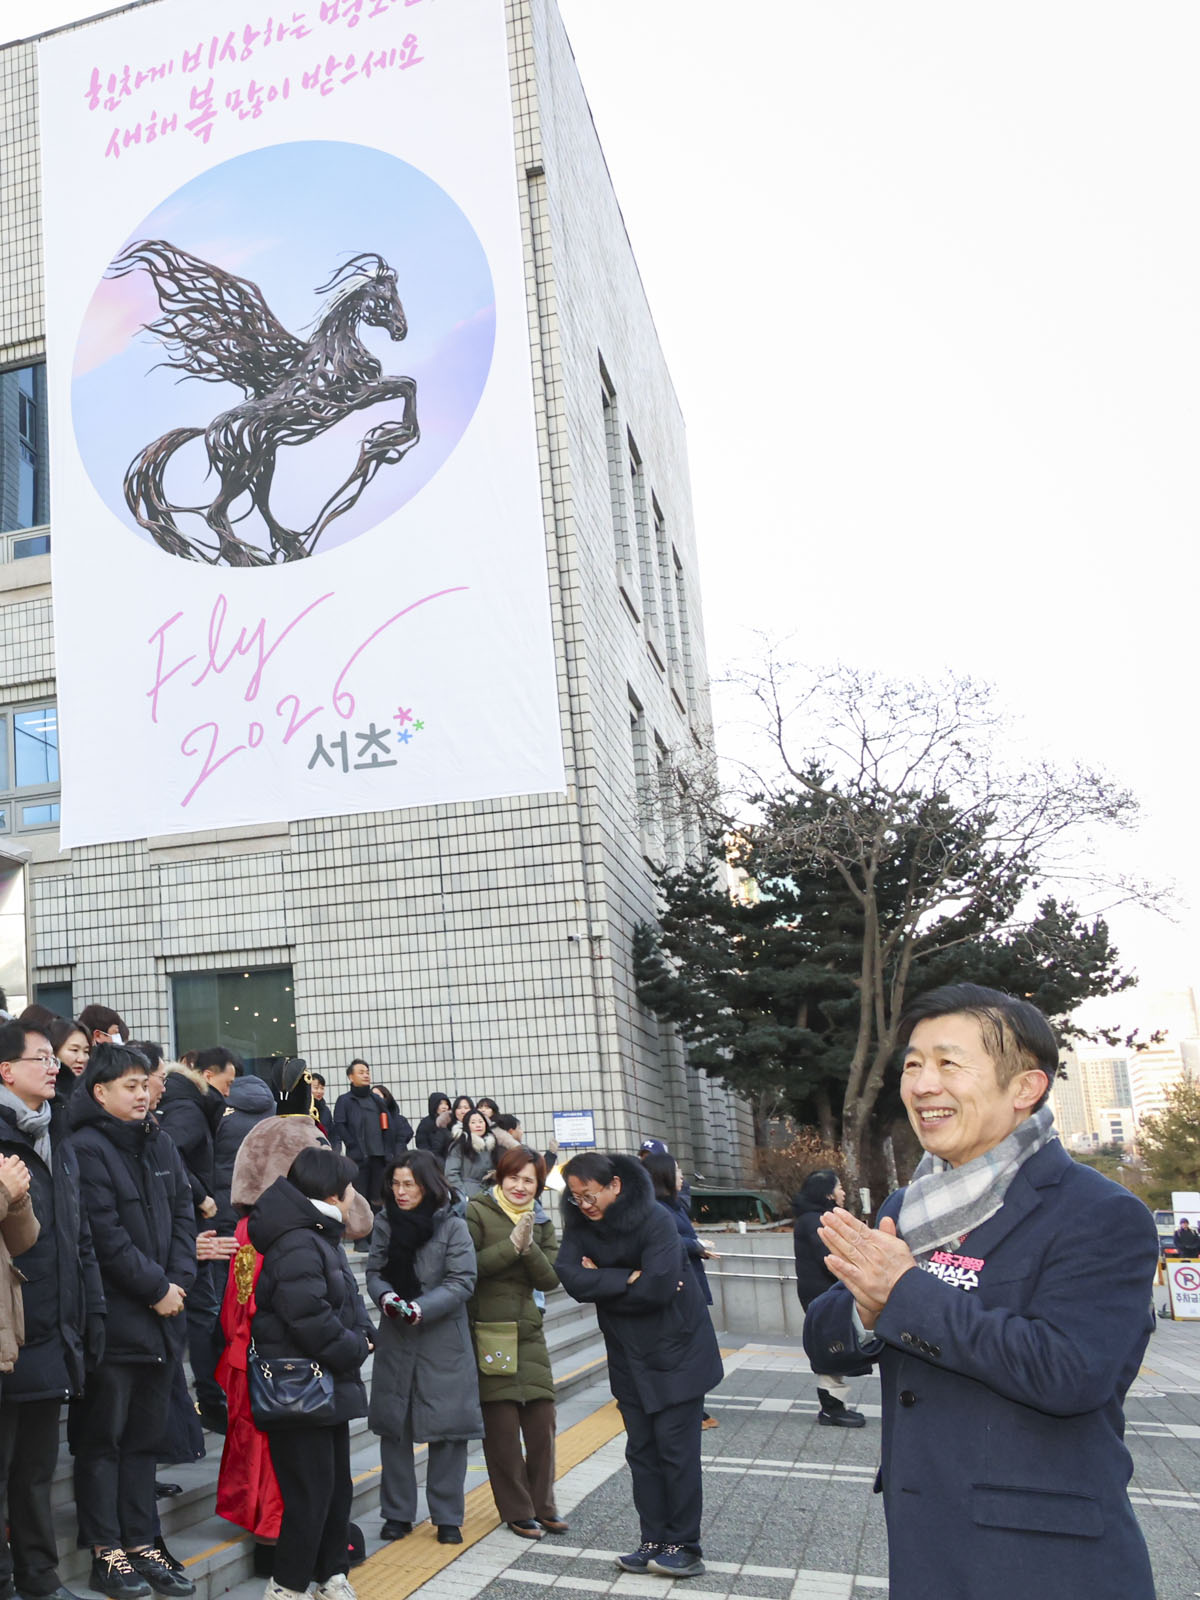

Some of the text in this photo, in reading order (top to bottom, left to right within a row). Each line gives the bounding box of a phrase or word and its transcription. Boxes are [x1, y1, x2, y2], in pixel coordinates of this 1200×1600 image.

[84, 59, 175, 113] 힘차게
[181, 13, 313, 73] 비상하는
[105, 33, 425, 159] 새해 복 많이 받으세요
[146, 591, 337, 724] Fly
[180, 586, 469, 807] 2026
[307, 722, 398, 774] 서초
[930, 1250, 985, 1272] 서초구청장
[1175, 1292, 1200, 1304] 주차금
